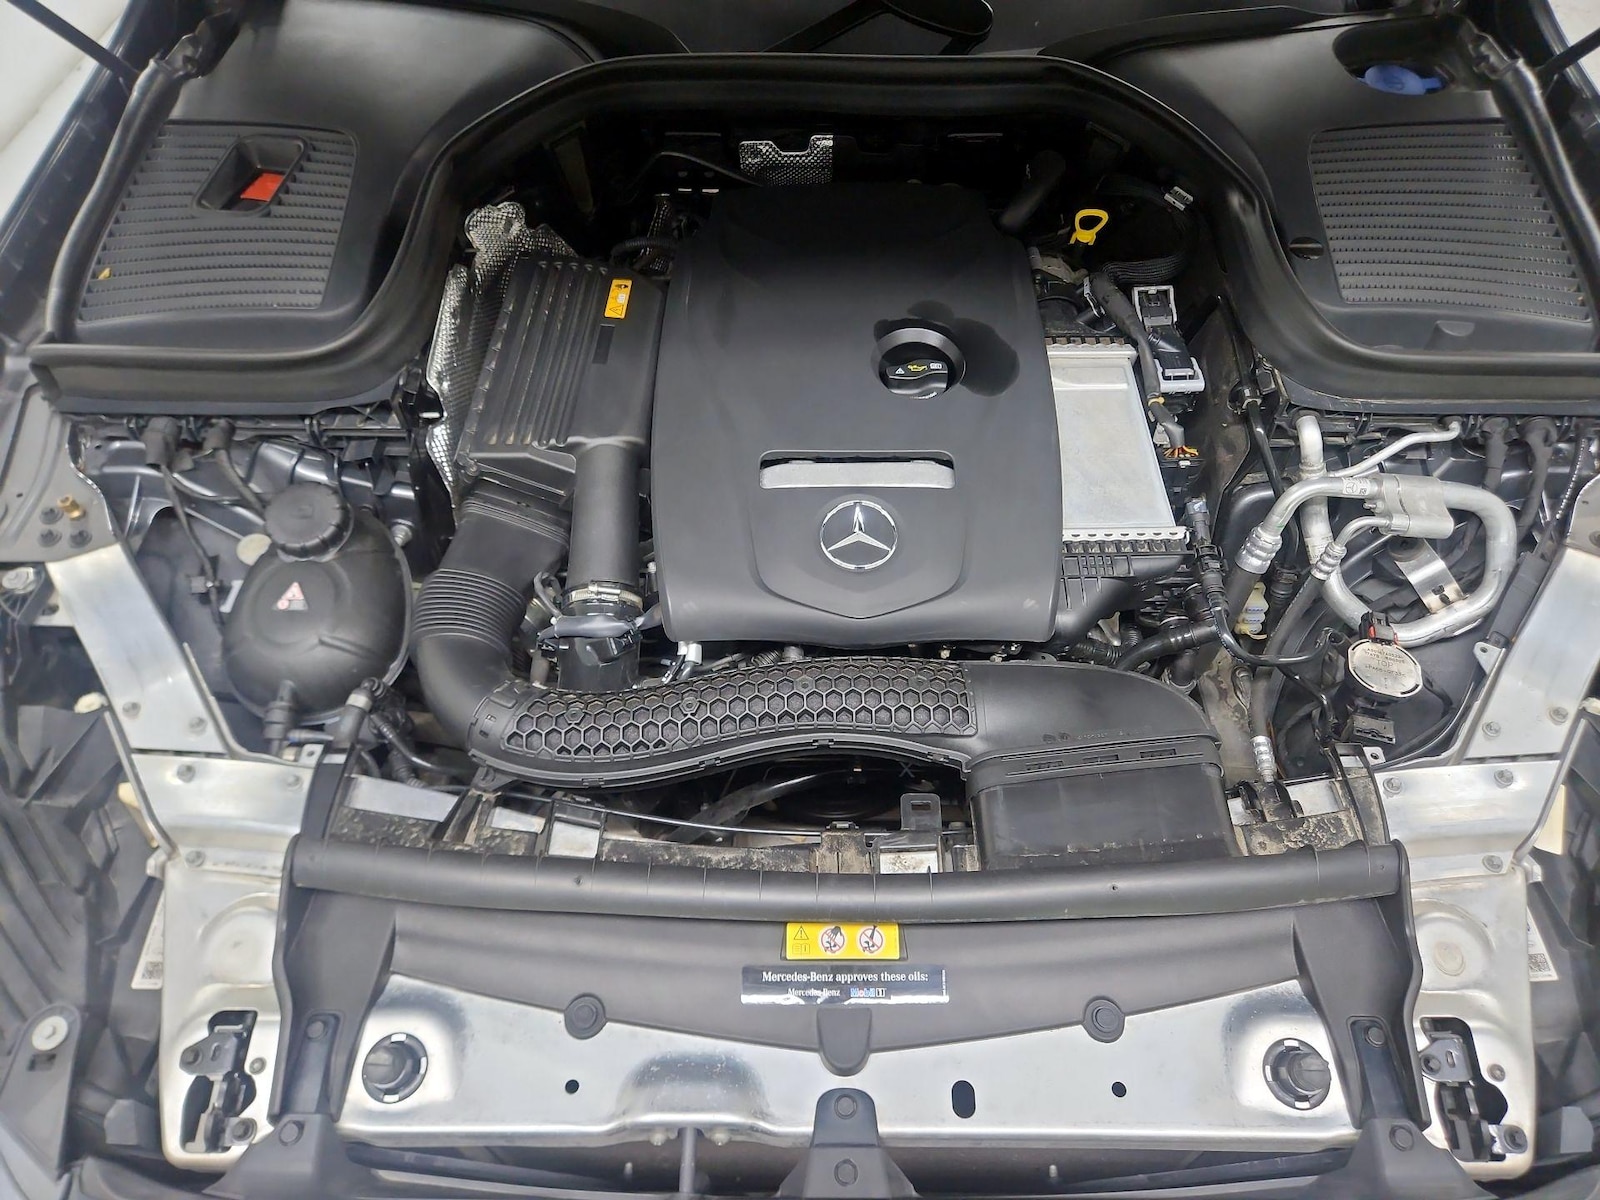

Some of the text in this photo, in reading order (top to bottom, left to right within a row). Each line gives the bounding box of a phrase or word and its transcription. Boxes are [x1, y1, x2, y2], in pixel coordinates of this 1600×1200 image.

[762, 971, 929, 984] Mercedes-Benz approves these oils:
[850, 987, 876, 998] Mobil
